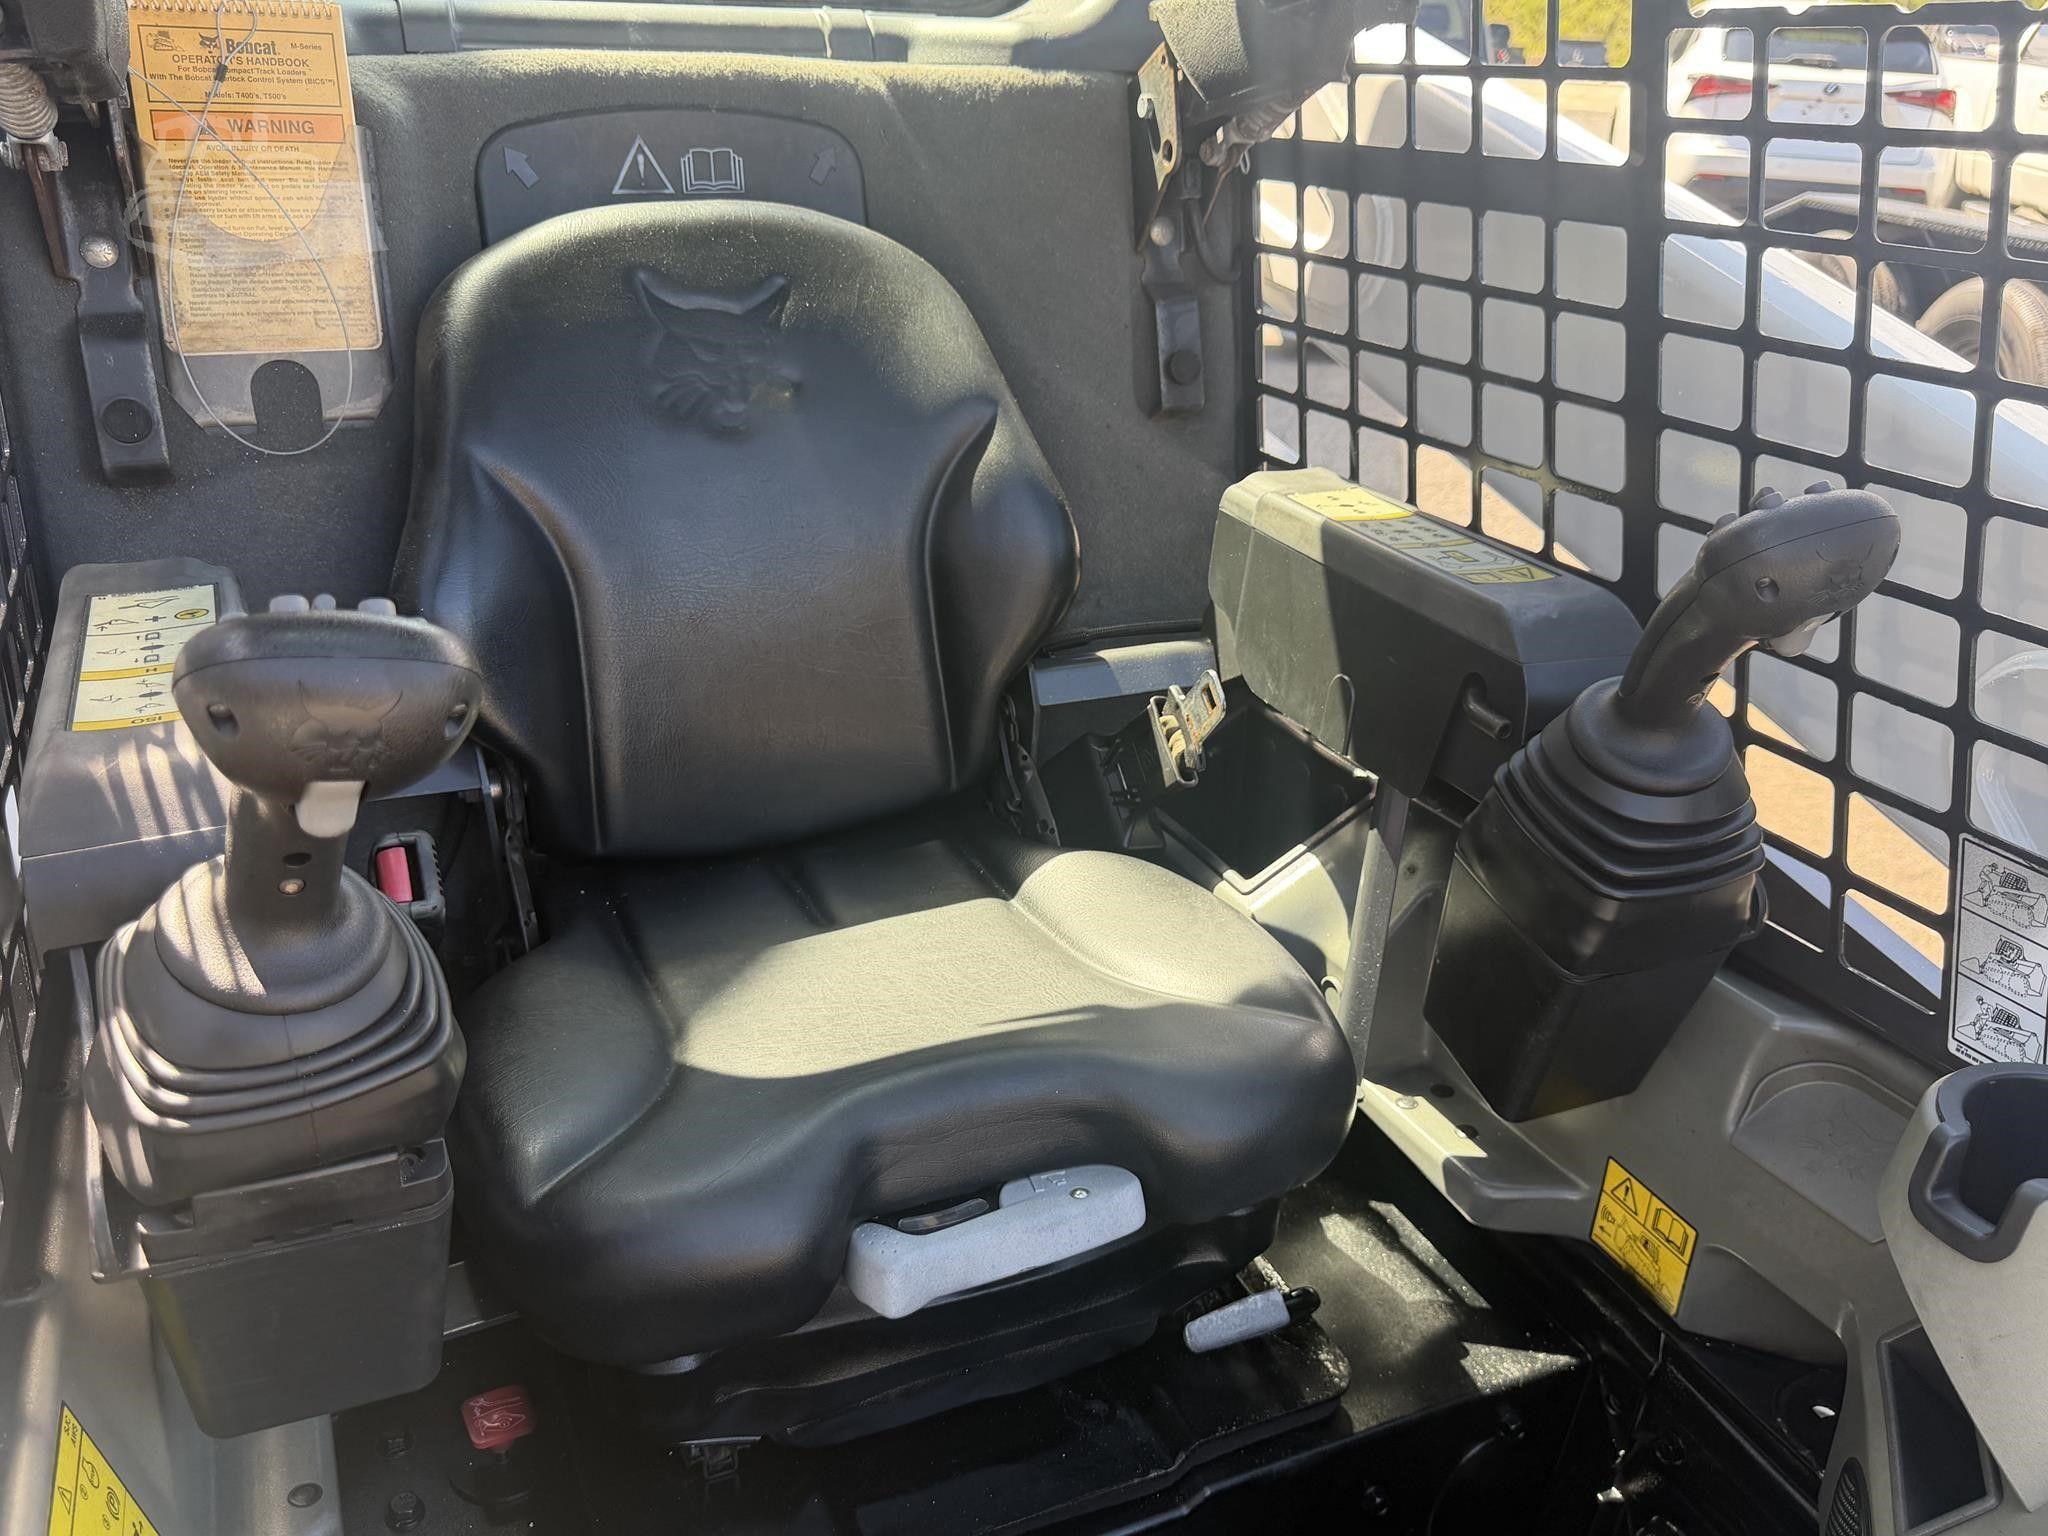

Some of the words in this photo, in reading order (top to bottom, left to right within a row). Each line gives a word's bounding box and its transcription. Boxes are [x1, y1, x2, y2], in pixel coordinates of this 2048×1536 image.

[290, 42, 322, 51] M-Series
[246, 56, 310, 68] HANDBOOK
[224, 67, 254, 75] ompact
[277, 68, 307, 76] Loaders
[168, 73, 184, 81] The
[276, 77, 303, 85] System
[227, 118, 315, 135] WARNING
